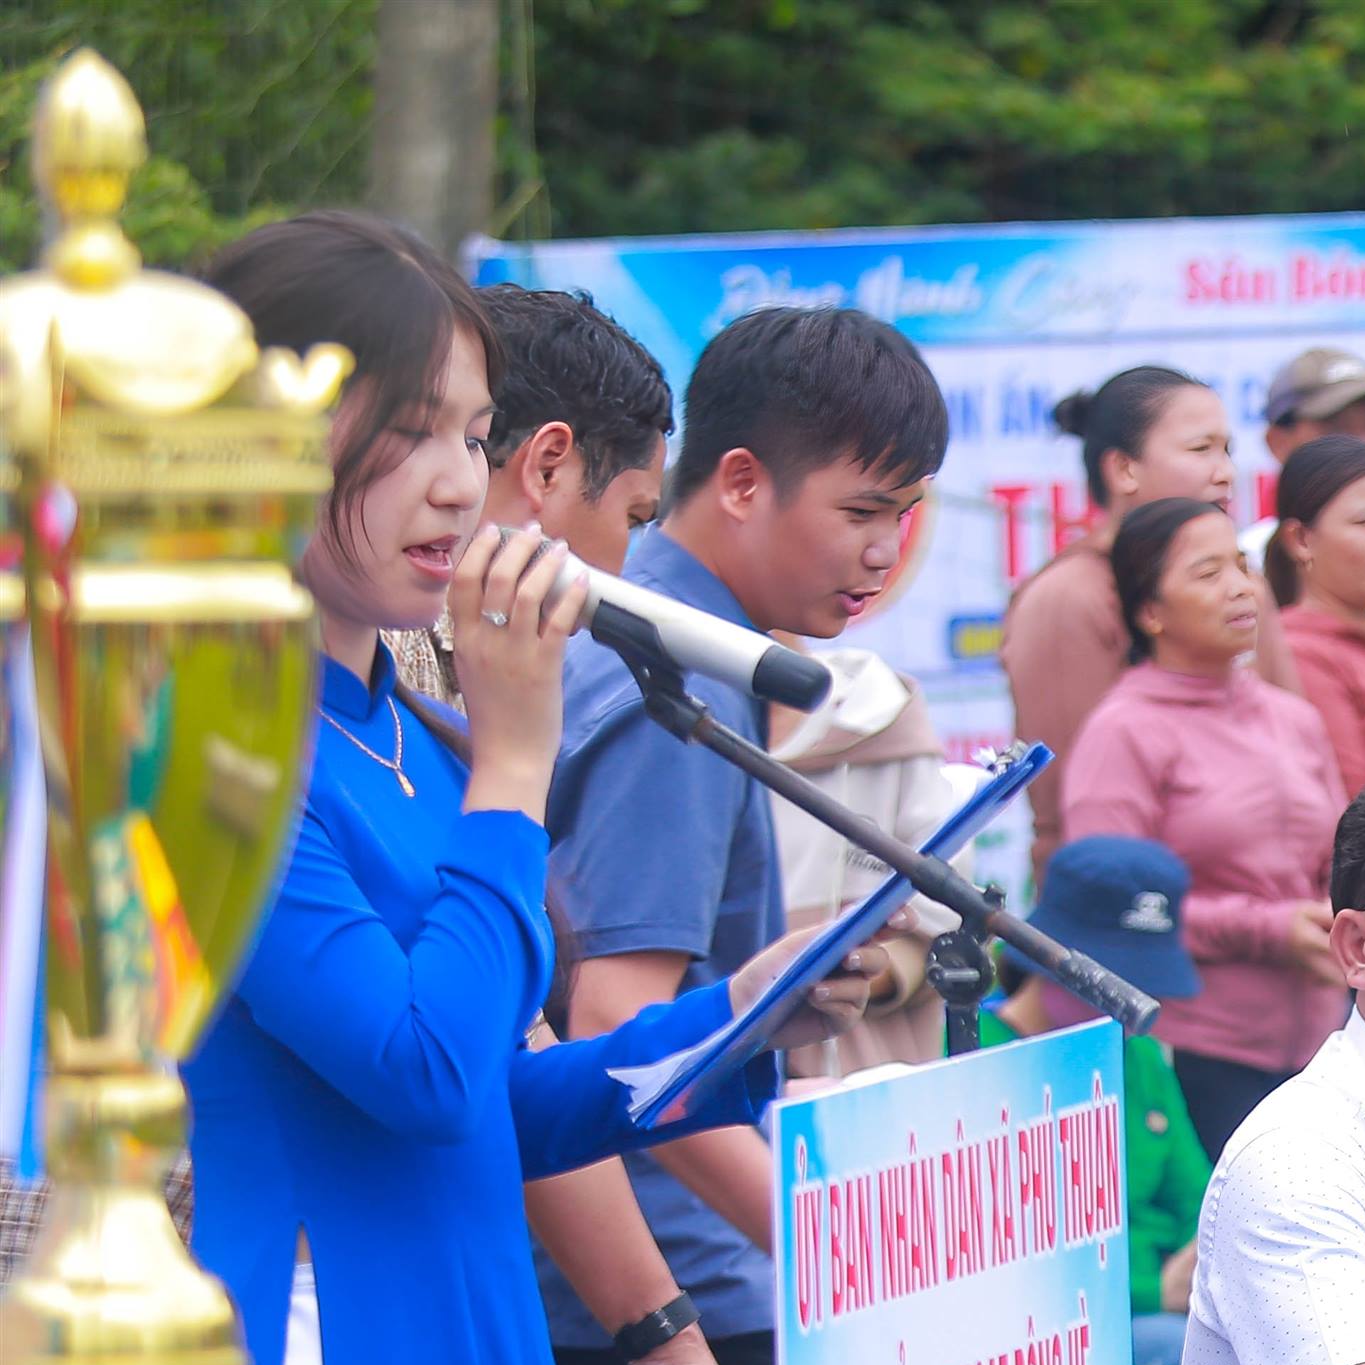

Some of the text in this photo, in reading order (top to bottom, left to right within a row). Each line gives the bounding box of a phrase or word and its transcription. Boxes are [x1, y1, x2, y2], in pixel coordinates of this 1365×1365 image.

[795, 1078, 1121, 1330] ỦY BAN NHÂN DÂN XÃ PHÚ THUẬN
